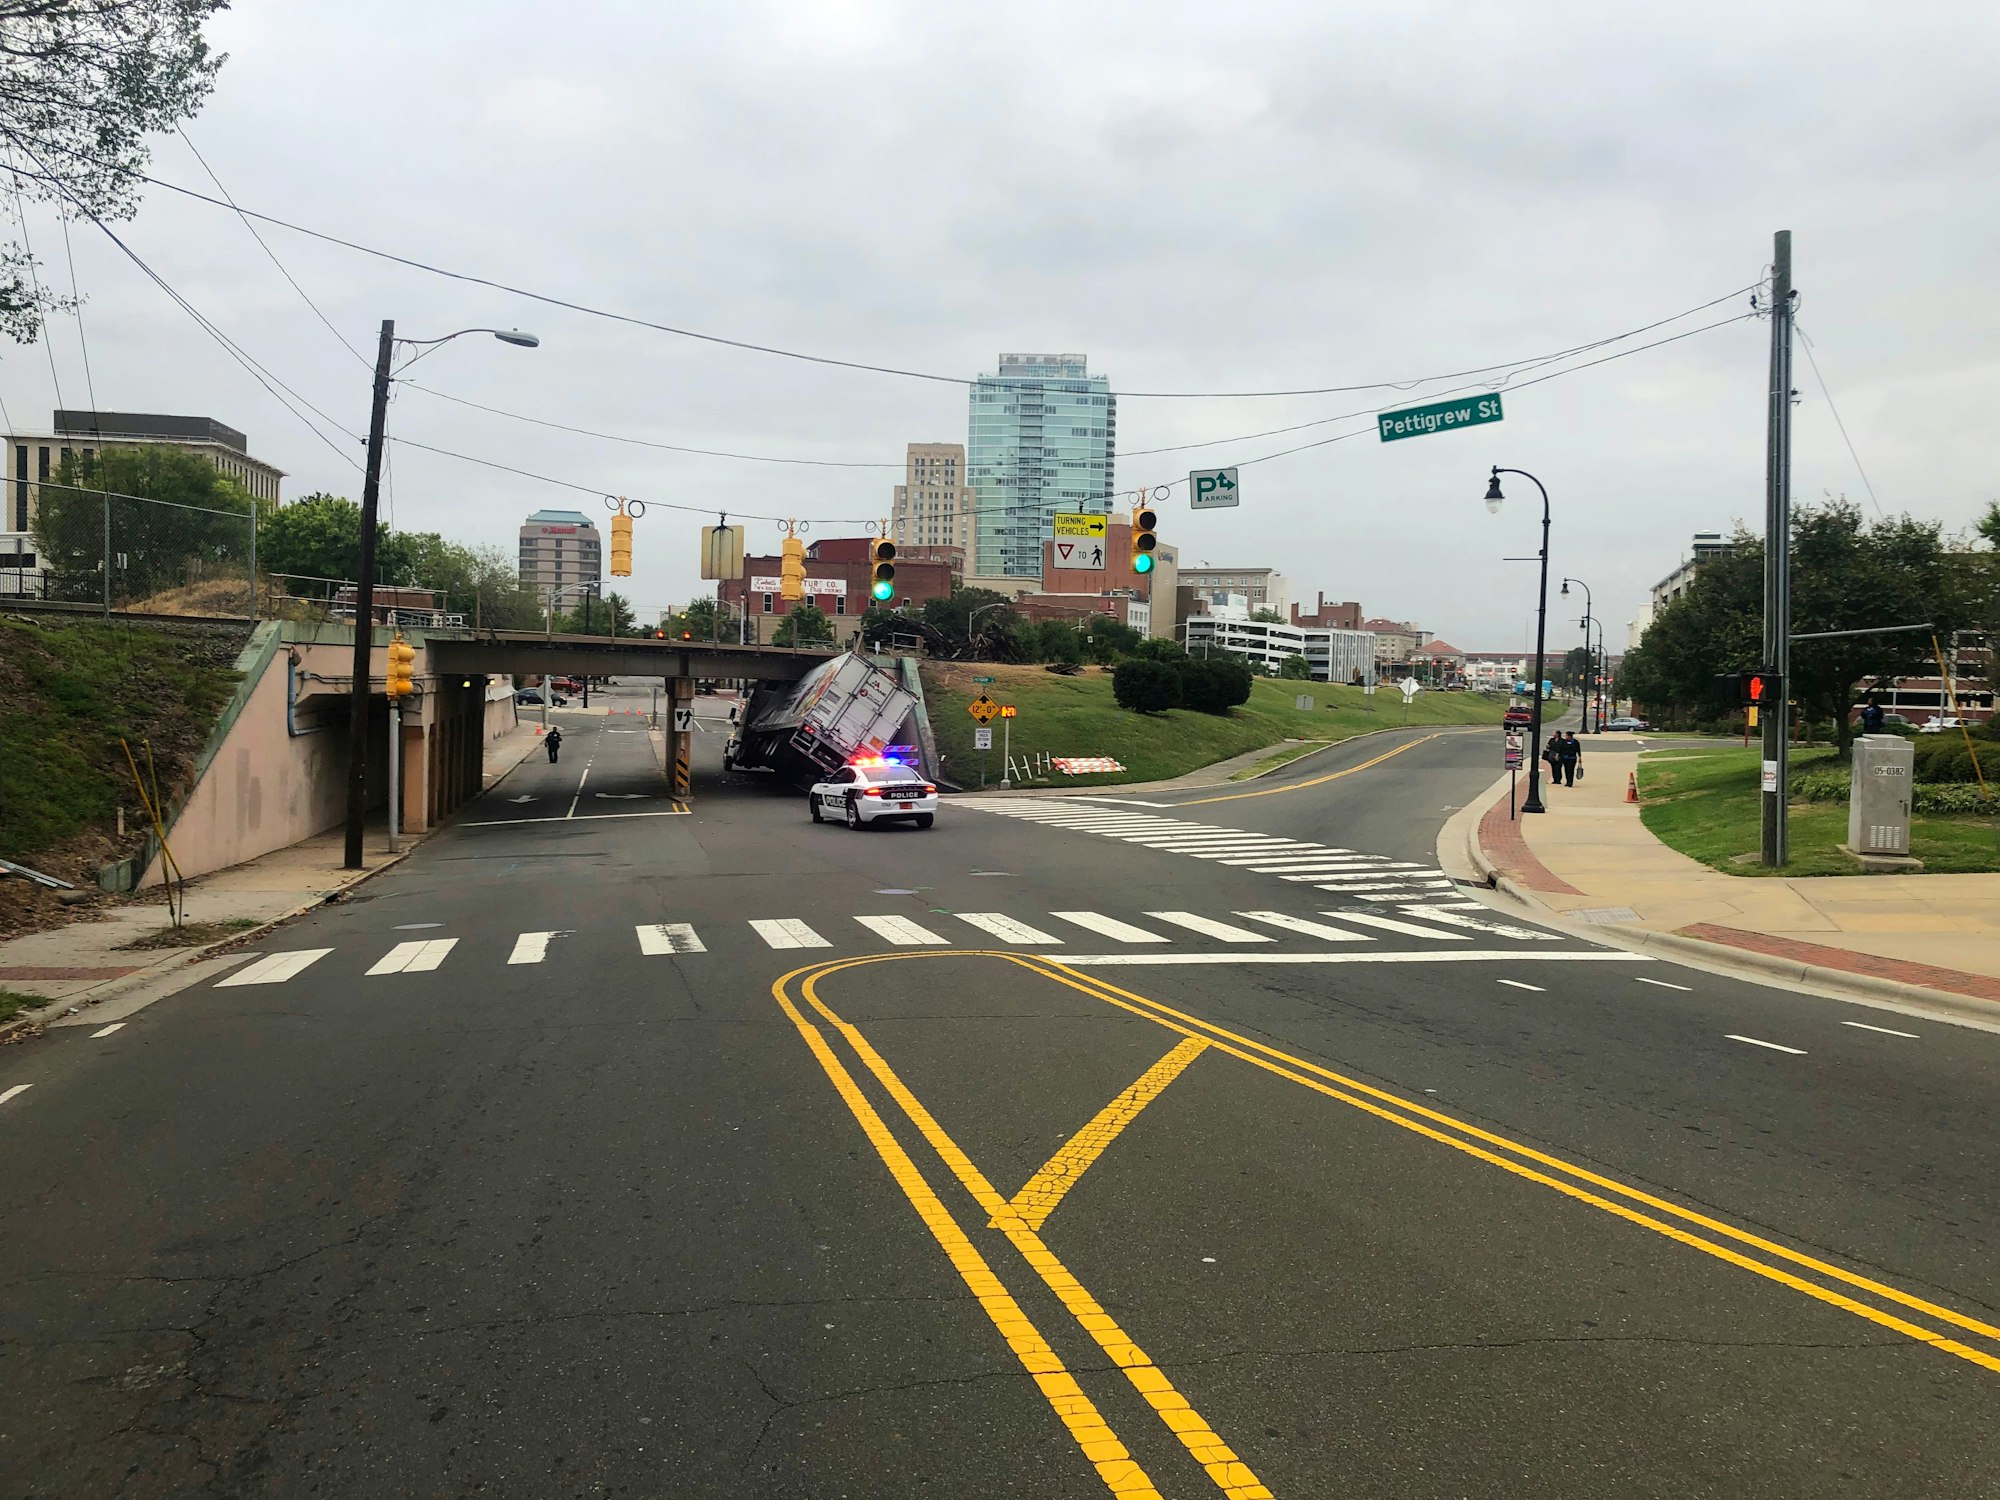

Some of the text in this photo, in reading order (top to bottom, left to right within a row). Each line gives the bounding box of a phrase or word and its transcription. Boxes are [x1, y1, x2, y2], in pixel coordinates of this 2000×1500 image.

[1381, 400, 1499, 436] Pettigrew St
[1057, 516, 1086, 525] TURNING
[1057, 527, 1089, 535] VEHICLES
[1078, 551, 1087, 559] TO
[1875, 767, 1904, 775] 05-0382
[825, 796, 847, 807] POLICE
